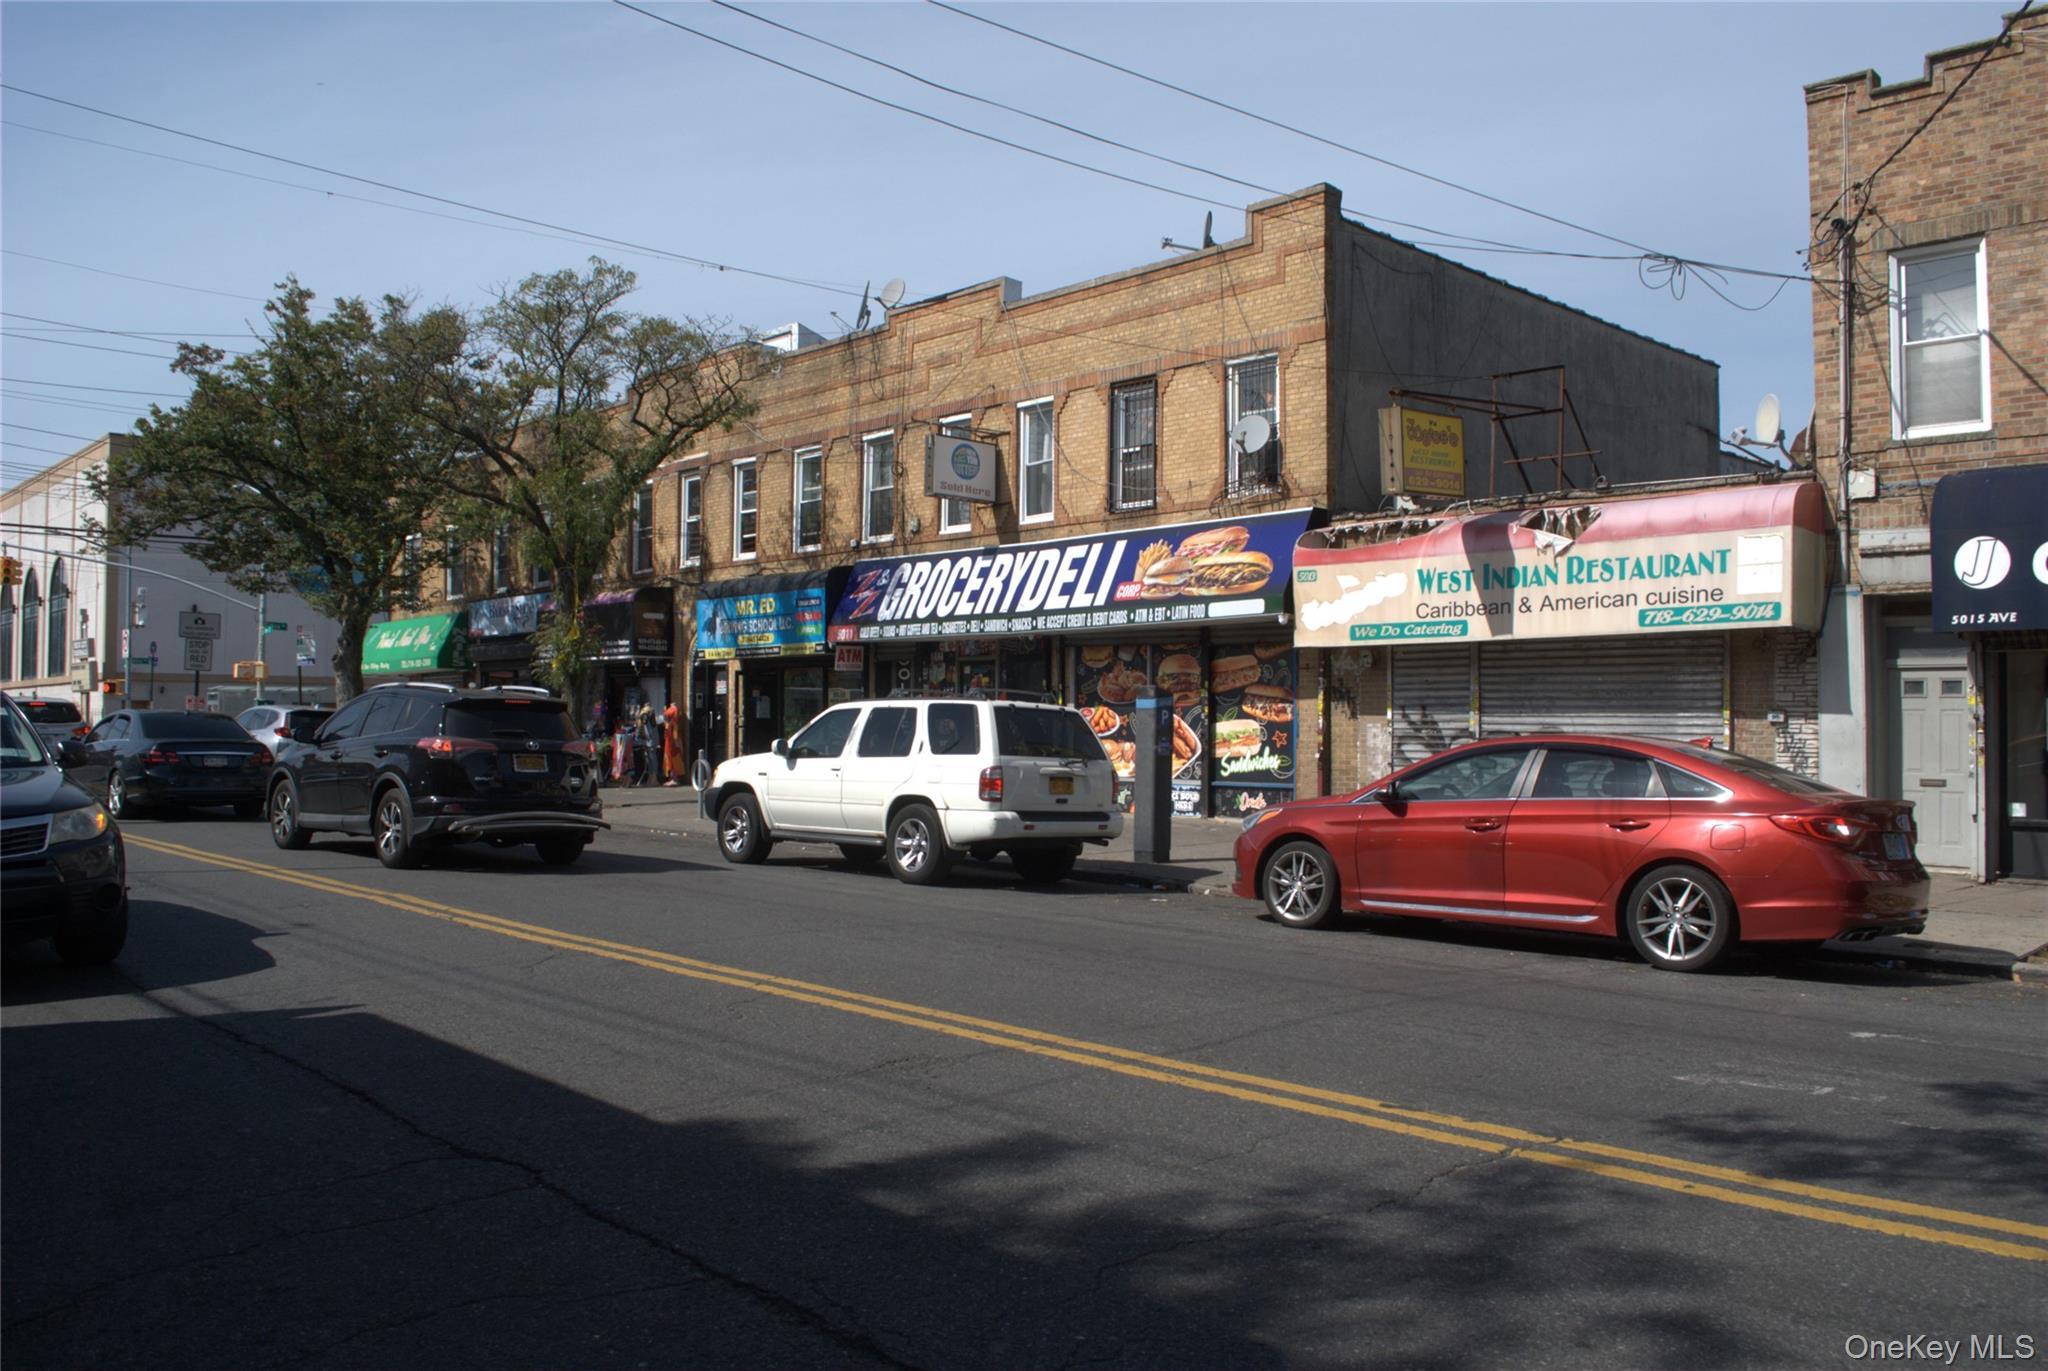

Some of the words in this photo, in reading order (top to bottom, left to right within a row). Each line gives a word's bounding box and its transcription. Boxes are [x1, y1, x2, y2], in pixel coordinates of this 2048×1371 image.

[1417, 568, 1474, 594] WEST
[1482, 559, 1560, 589] INDIAN
[1566, 548, 1732, 586] RESTAURANT
[736, 600, 757, 616] MR.
[760, 597, 776, 614] ED
[1415, 601, 1512, 621] Caribbean
[1518, 598, 1534, 614] &
[1540, 593, 1638, 612] American
[1645, 586, 1724, 606] cuisine
[1011, 616, 1032, 632] SNACKS
[1037, 616, 1046, 629] WE
[1047, 614, 1066, 629] ACCEPT
[1067, 613, 1086, 627] CREDIT
[1093, 612, 1108, 626] DEBIT
[1109, 610, 1128, 625] CARDS
[1135, 608, 1148, 622] ATM
[1155, 607, 1166, 620] EBT
[1172, 605, 1189, 620] LATIN
[1190, 603, 1206, 618] FOOD
[1643, 604, 1777, 626] 718-629-9014
[1951, 614, 1985, 625] 5015
[1988, 612, 2018, 623] AVE
[1354, 627, 1377, 640] We
[1381, 626, 1400, 638] Do
[1403, 622, 1463, 640] Catering
[837, 650, 862, 663] ATM
